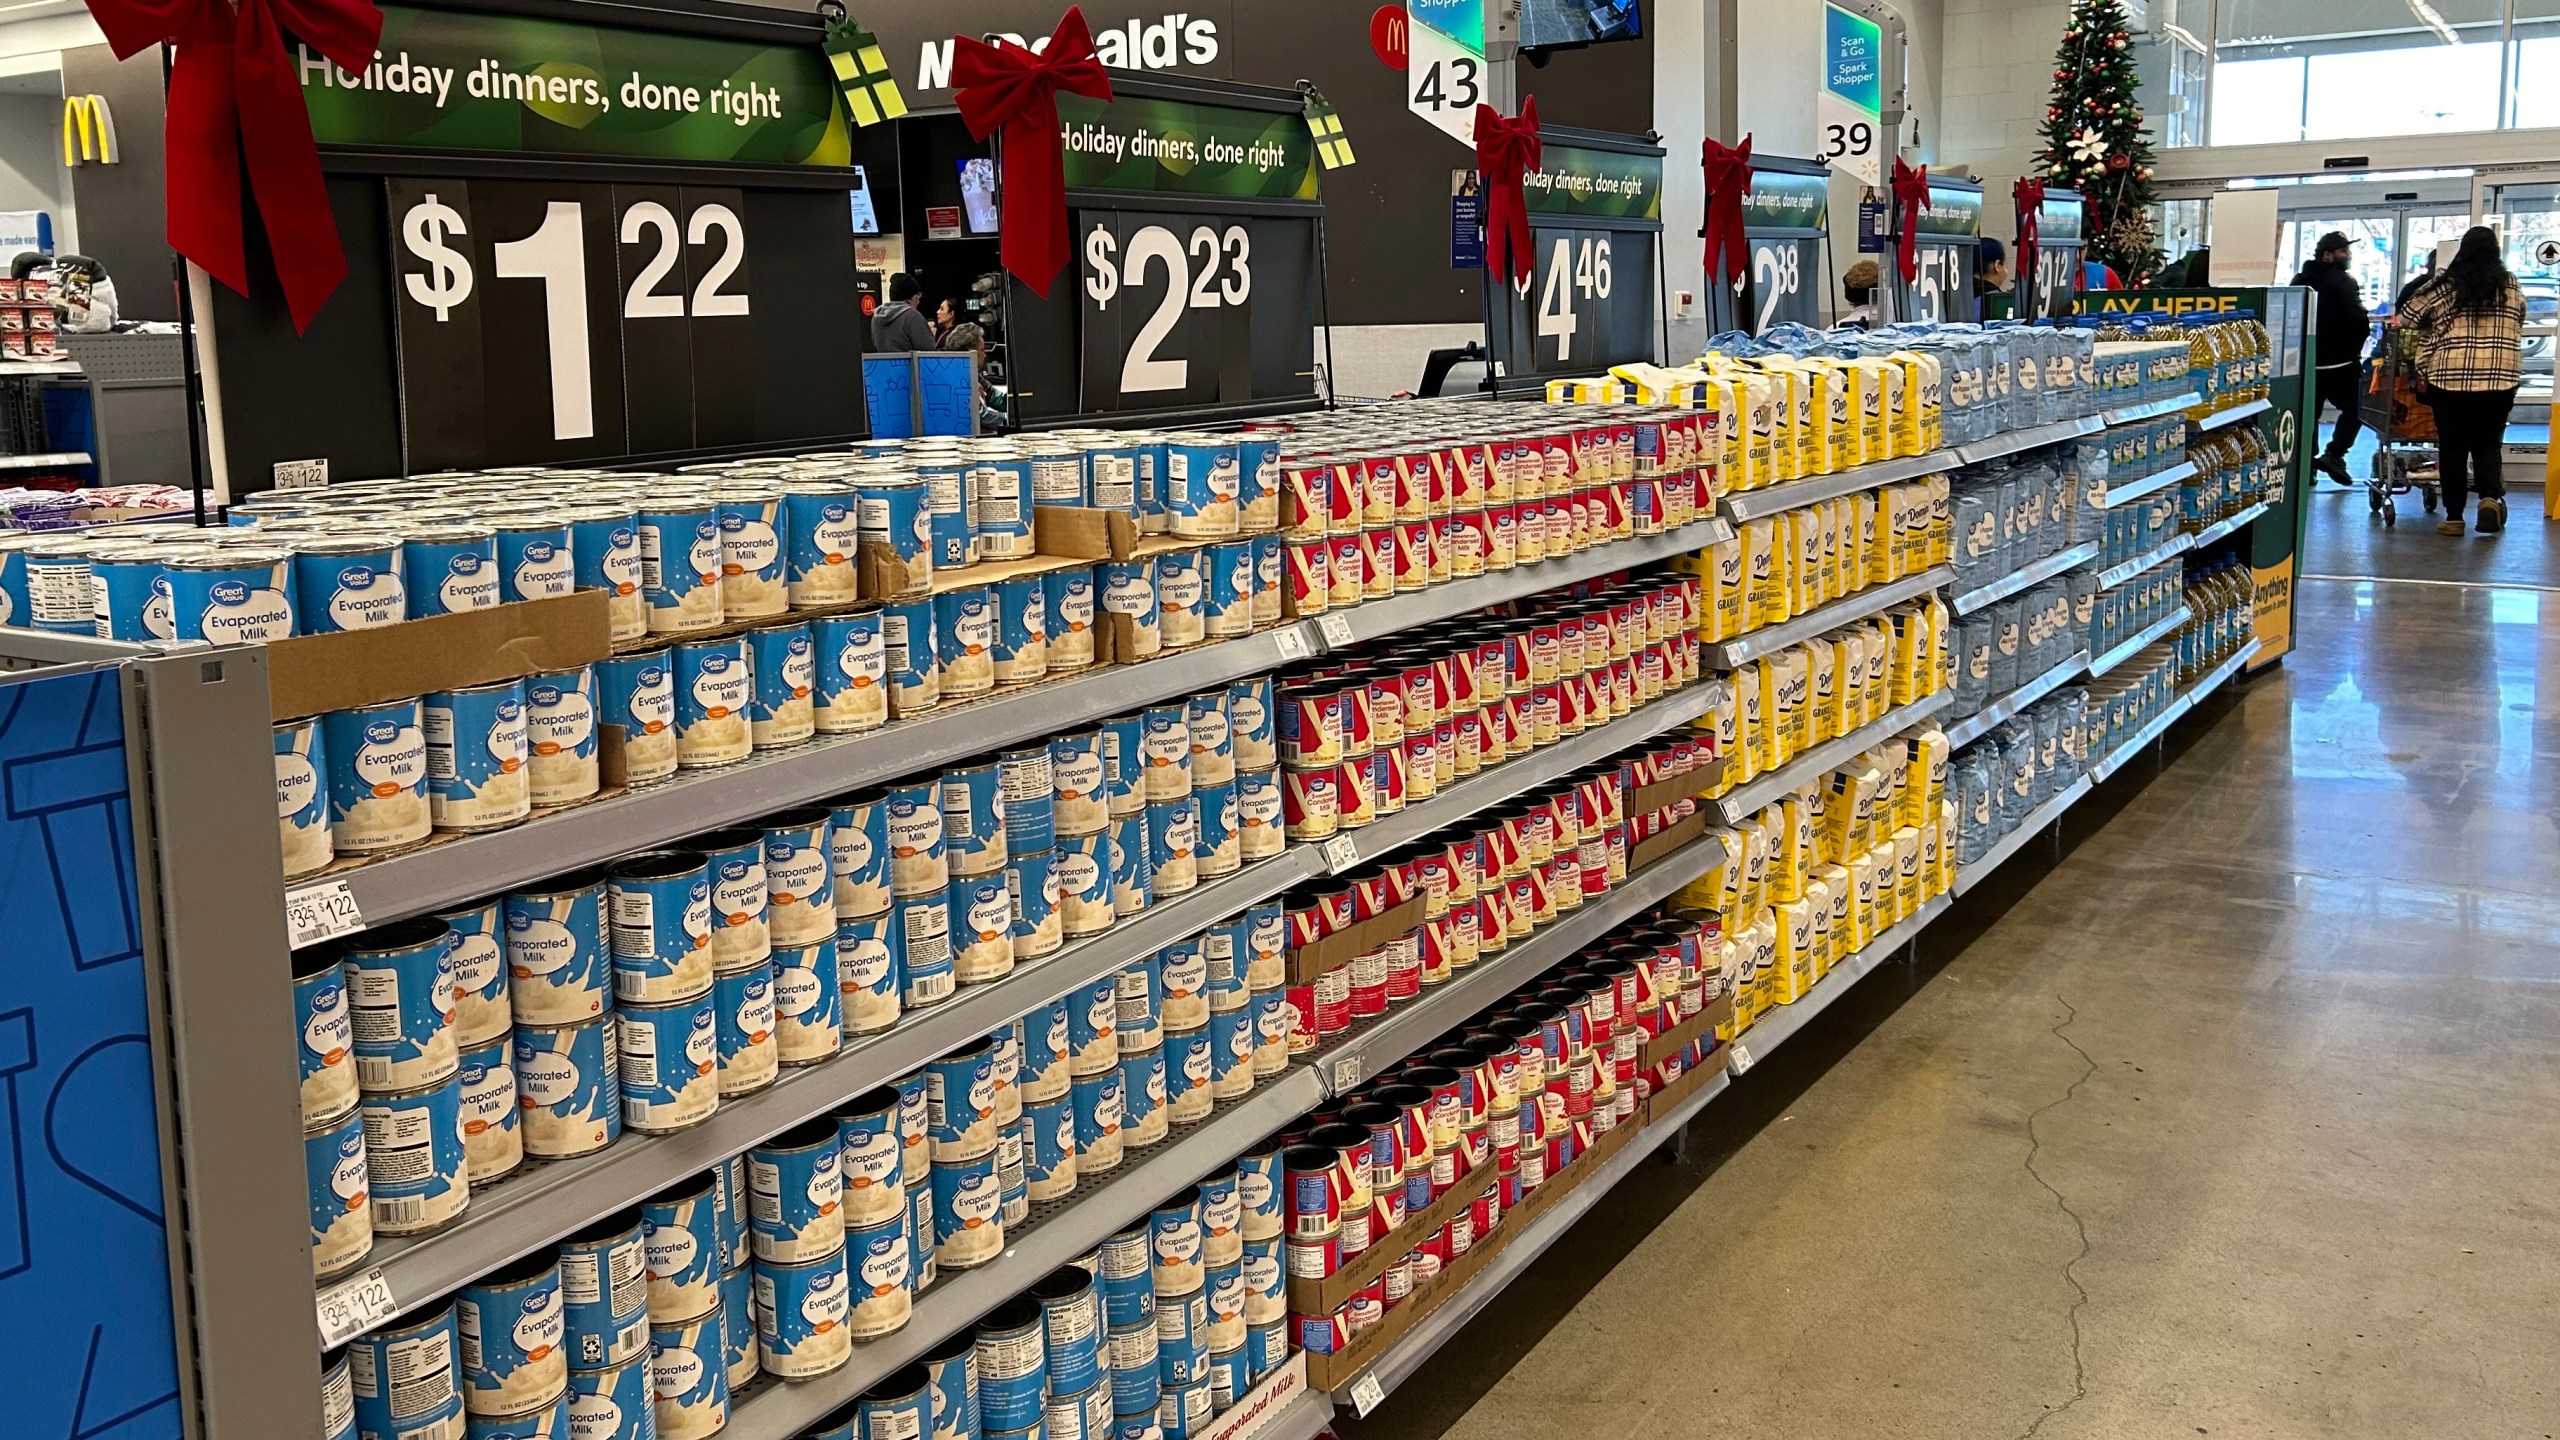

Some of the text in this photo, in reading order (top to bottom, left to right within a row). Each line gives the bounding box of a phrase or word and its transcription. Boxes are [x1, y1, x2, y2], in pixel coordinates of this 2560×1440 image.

[1841, 37, 1864, 46] Scan
[1841, 47, 1864, 57] & Go
[1840, 62, 1867, 75] Spark
[1414, 58, 1479, 112] 43
[1833, 73, 1874, 85] Shopper
[468, 60, 608, 113] dinners,
[620, 74, 698, 115] done
[710, 79, 782, 127] right
[1826, 123, 1871, 157] 39
[1131, 129, 1199, 164] dinners,
[1205, 136, 1242, 163] done
[1246, 141, 1284, 172] right
[1524, 168, 1642, 199] oliday dinners, done right
[1757, 190, 1813, 212] dinners, done right
[722, 539, 773, 551] vaporated
[736, 548, 758, 560] Milk
[545, 581, 565, 593] Milk
[1159, 580, 1201, 592] Evaporated
[2255, 575, 2287, 605] Anything
[472, 595, 491, 607] Milk
[1107, 589, 1151, 602] Evaporated
[1174, 590, 1190, 602] Milk
[1122, 600, 1139, 611] Milk
[210, 608, 287, 629] Evaporated
[365, 609, 389, 622] Milk
[240, 626, 267, 640] Milk
[720, 689, 739, 701] Milk
[529, 709, 589, 727] Evaporated
[551, 724, 575, 737] Milk
[1164, 743, 1179, 754] Milk
[364, 745, 425, 766] Evaporated
[391, 761, 413, 775] Milk
[1056, 765, 1100, 779] Evaporated
[1072, 775, 1089, 785] Milk
[1242, 797, 1279, 809] Evaporated
[1256, 805, 1270, 814] Milk
[890, 818, 940, 834] Evaporated
[908, 831, 927, 843] Milk
[767, 862, 823, 879] Evaporated
[787, 876, 807, 887] Milk
[741, 895, 758, 906] Milk
[524, 950, 546, 962] Milk
[851, 966, 871, 978] Milk
[1182, 975, 1196, 986] Milk
[529, 1081, 550, 1093] Milk
[479, 1098, 501, 1115] Milk
[845, 1144, 896, 1163] Evaporated
[864, 1160, 883, 1171] Milk
[976, 1200, 999, 1212] Milk
[1174, 1243, 1190, 1254] Milk
[1251, 1275, 1265, 1285] Milk
[1269, 1372, 1295, 1403] Milk
